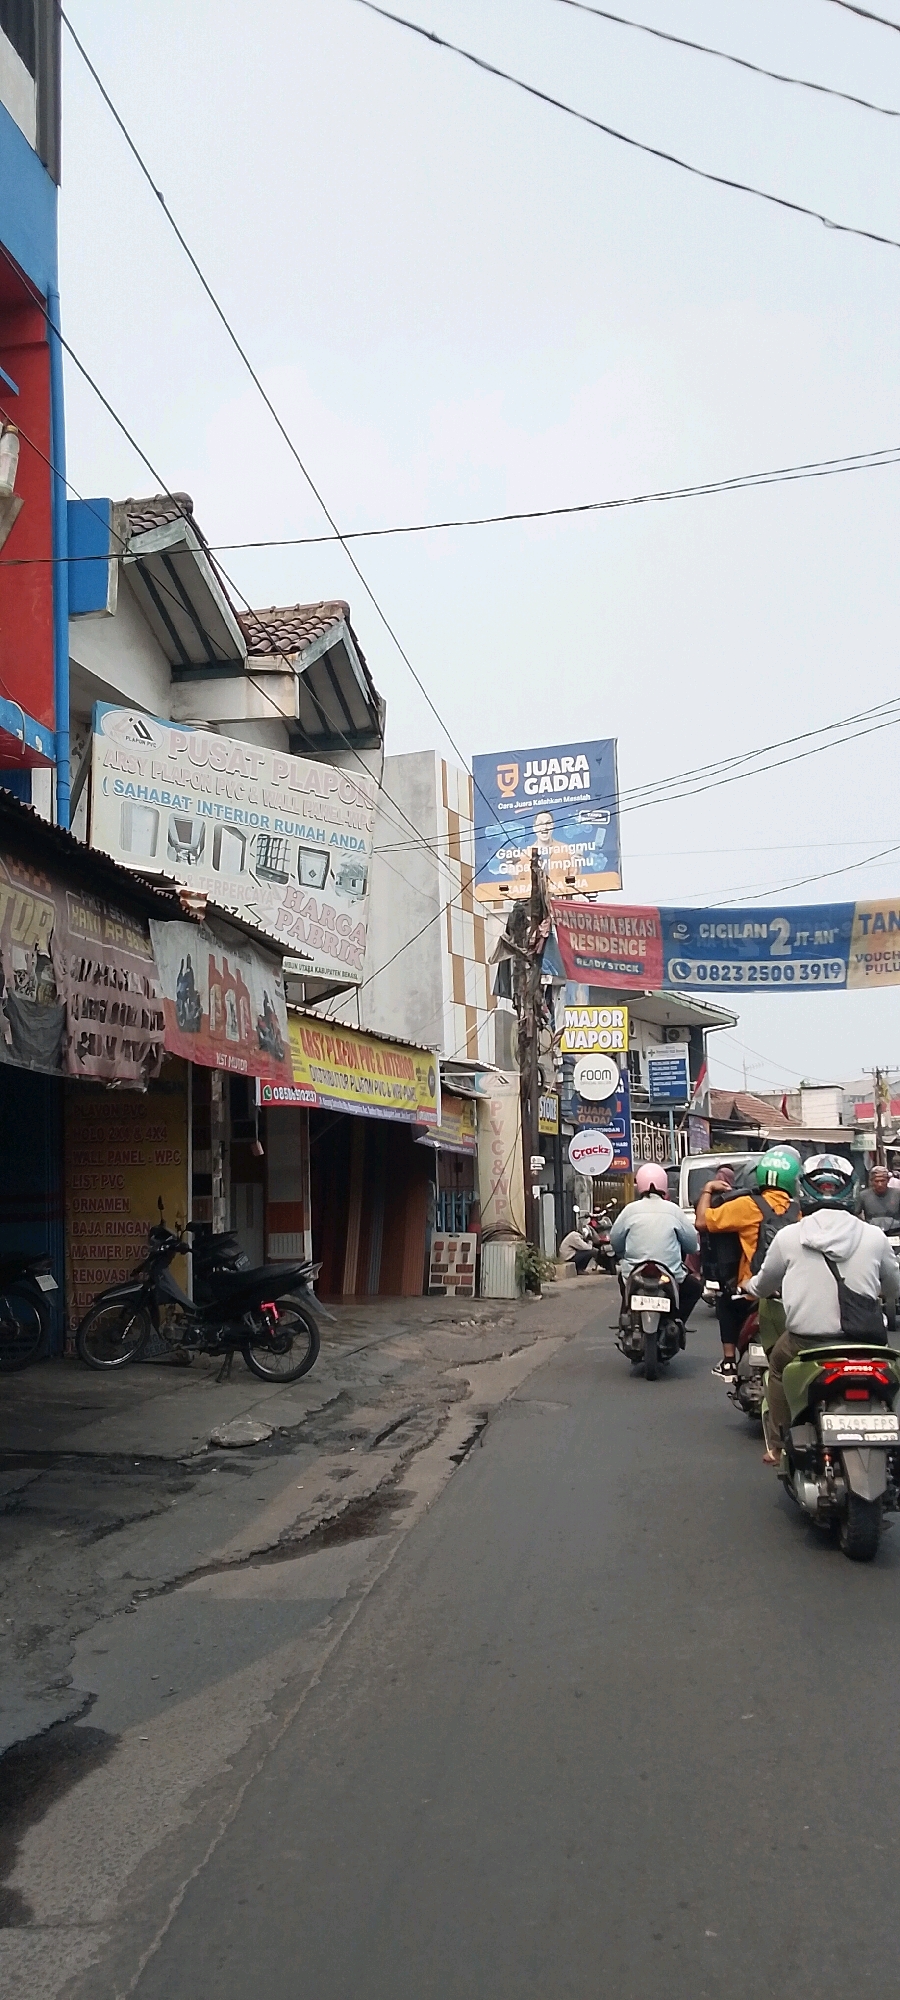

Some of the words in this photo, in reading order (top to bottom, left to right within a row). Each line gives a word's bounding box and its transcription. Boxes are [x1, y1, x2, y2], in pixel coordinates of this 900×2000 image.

[125, 735, 146, 746] PLAPON
[146, 740, 157, 749] PVC
[167, 729, 265, 780] PUSAT
[270, 758, 375, 810] PLAPON
[523, 754, 590, 778] JUARA
[103, 749, 148, 777] ARSY
[151, 761, 212, 793] PLAPON
[215, 776, 246, 801] PVC
[262, 788, 300, 815] WALL
[523, 771, 591, 796] GADAI
[514, 800, 533, 809] Juara
[532, 798, 562, 807] Kalahkan
[113, 778, 193, 812] SAHABAT
[196, 799, 270, 830] INTERIOR
[274, 818, 326, 844] RUMAH
[329, 832, 367, 853] ANDA
[198, 875, 274, 906] TERPERCAYA
[283, 886, 367, 947] HARGA
[554, 908, 617, 935] PANORAMA
[618, 916, 657, 938] BEKASI
[275, 907, 364, 971] PABRIK
[569, 932, 647, 957] RESIDENCE
[699, 923, 768, 939] CICILAN
[768, 917, 792, 956] 2
[314, 966, 341, 977] KABUPATEN
[575, 957, 606, 969] READY
[607, 962, 640, 973] STOCK
[696, 964, 743, 982] 0823
[747, 964, 795, 982] 2500
[799, 962, 842, 980] 3919
[565, 1009, 625, 1028] MAJOR
[564, 1031, 624, 1049] VAPOR
[580, 1069, 612, 1081] FOOM
[539, 1096, 557, 1121] STORE
[577, 1104, 613, 1118] JUARA
[145, 1125, 168, 1142] 4X4
[73, 1149, 104, 1165] WALL
[107, 1150, 146, 1166] PANEL
[154, 1149, 181, 1166] WPC
[571, 1145, 611, 1161] Crackz
[760, 1156, 791, 1171] Grab
[72, 1174, 98, 1190] LIST
[101, 1174, 125, 1190] PVC
[72, 1196, 131, 1213] ORNAMEN
[71, 1220, 103, 1237] BAJA
[105, 1221, 151, 1237] RINGAN
[71, 1244, 123, 1260] MARMER
[125, 1244, 149, 1260] PVC
[72, 1268, 130, 1285] RENOVASI
[826, 1418, 834, 1430] B
[873, 1418, 896, 1430] FPS
